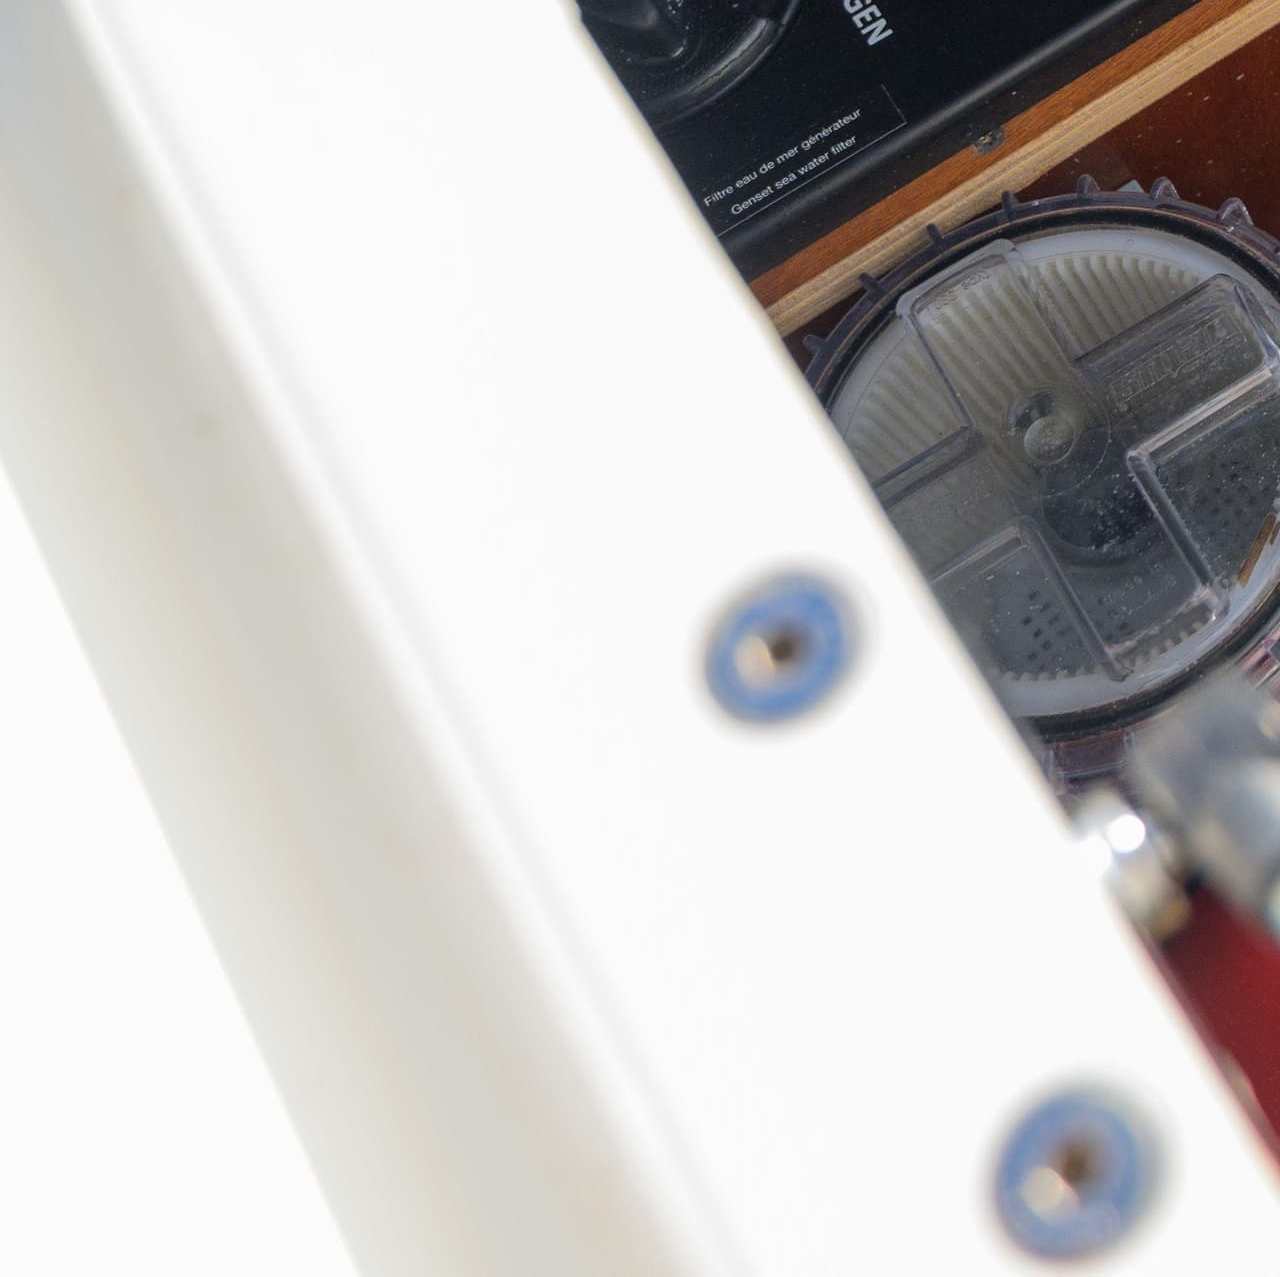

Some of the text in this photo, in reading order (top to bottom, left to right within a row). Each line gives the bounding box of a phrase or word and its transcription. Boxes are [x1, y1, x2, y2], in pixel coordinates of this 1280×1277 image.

[702, 107, 861, 207] Filtre eau de mer générateur
[729, 134, 856, 215] Genset sea water filter
